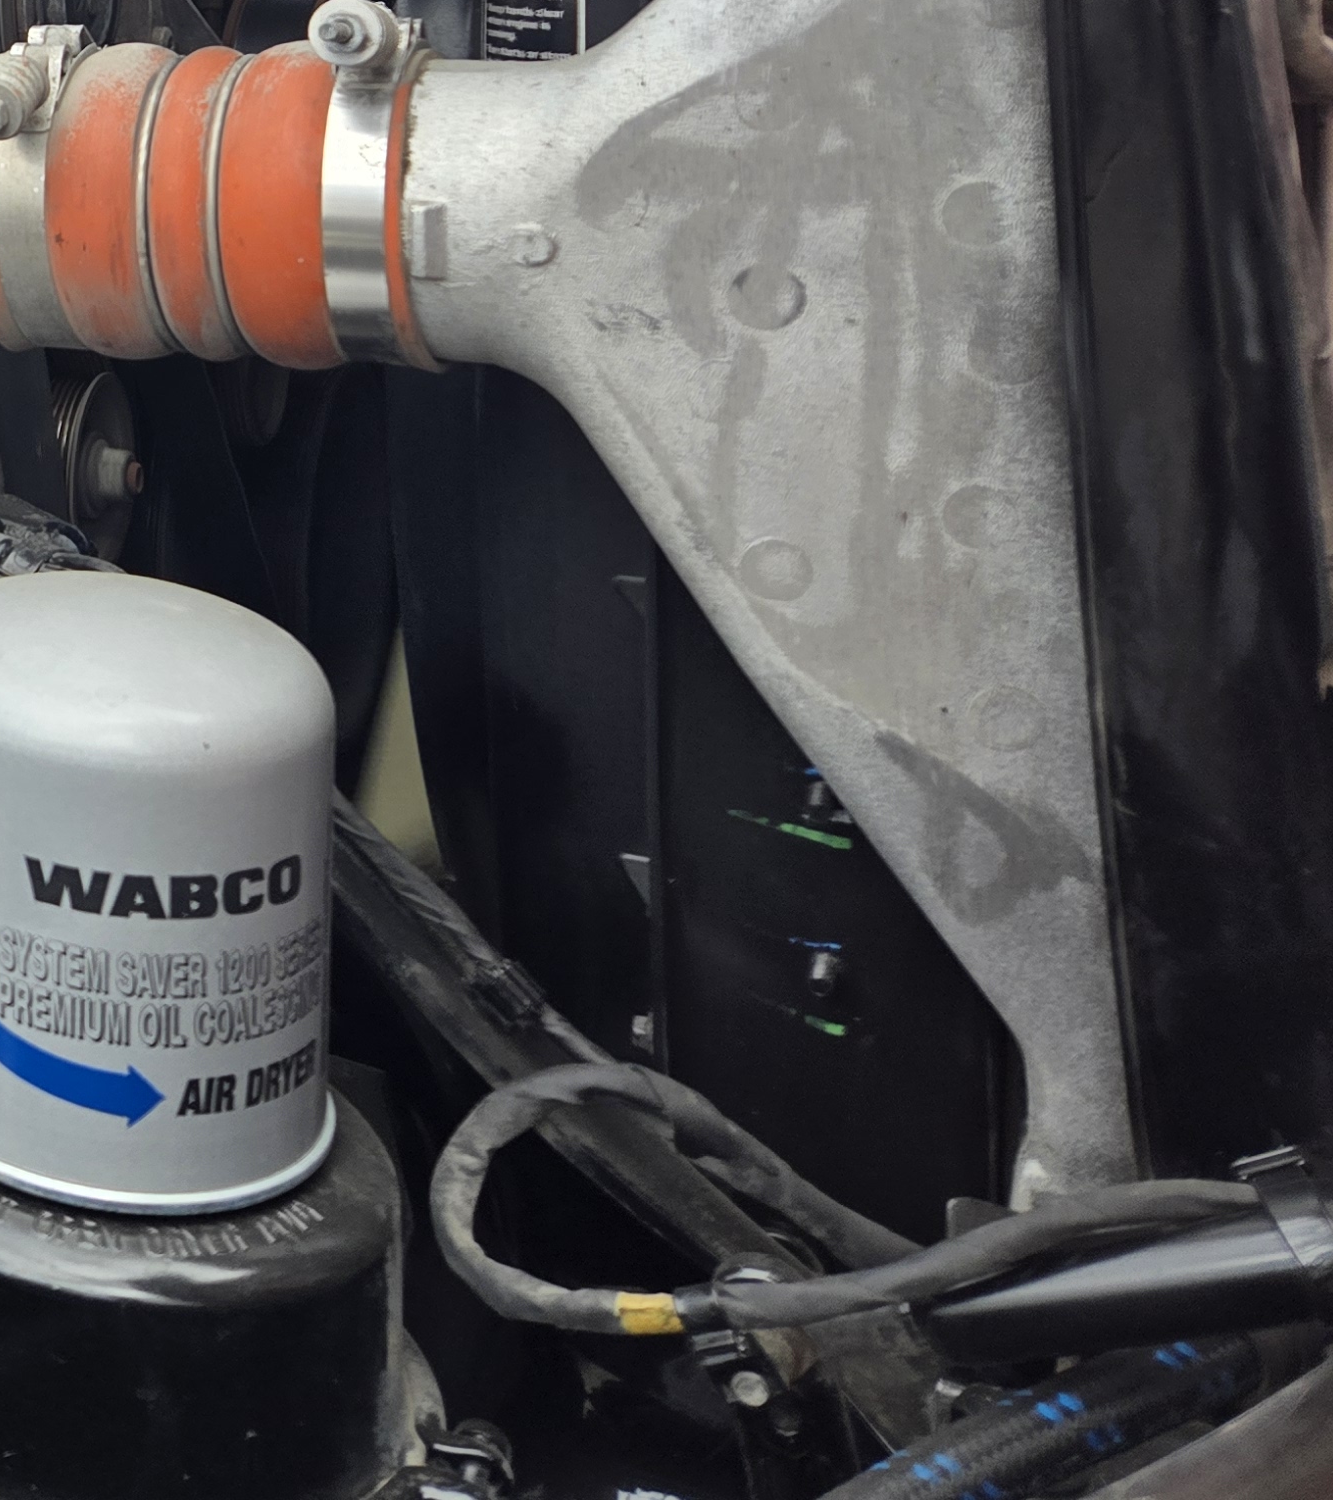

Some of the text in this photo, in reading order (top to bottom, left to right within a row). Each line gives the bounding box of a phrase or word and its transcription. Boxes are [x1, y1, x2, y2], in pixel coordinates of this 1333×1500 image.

[24, 853, 302, 920] WABCO
[115, 951, 208, 998] SAVER
[215, 942, 271, 996] 1200
[137, 1002, 189, 1049] OIL
[176, 1073, 237, 1117] AIR
